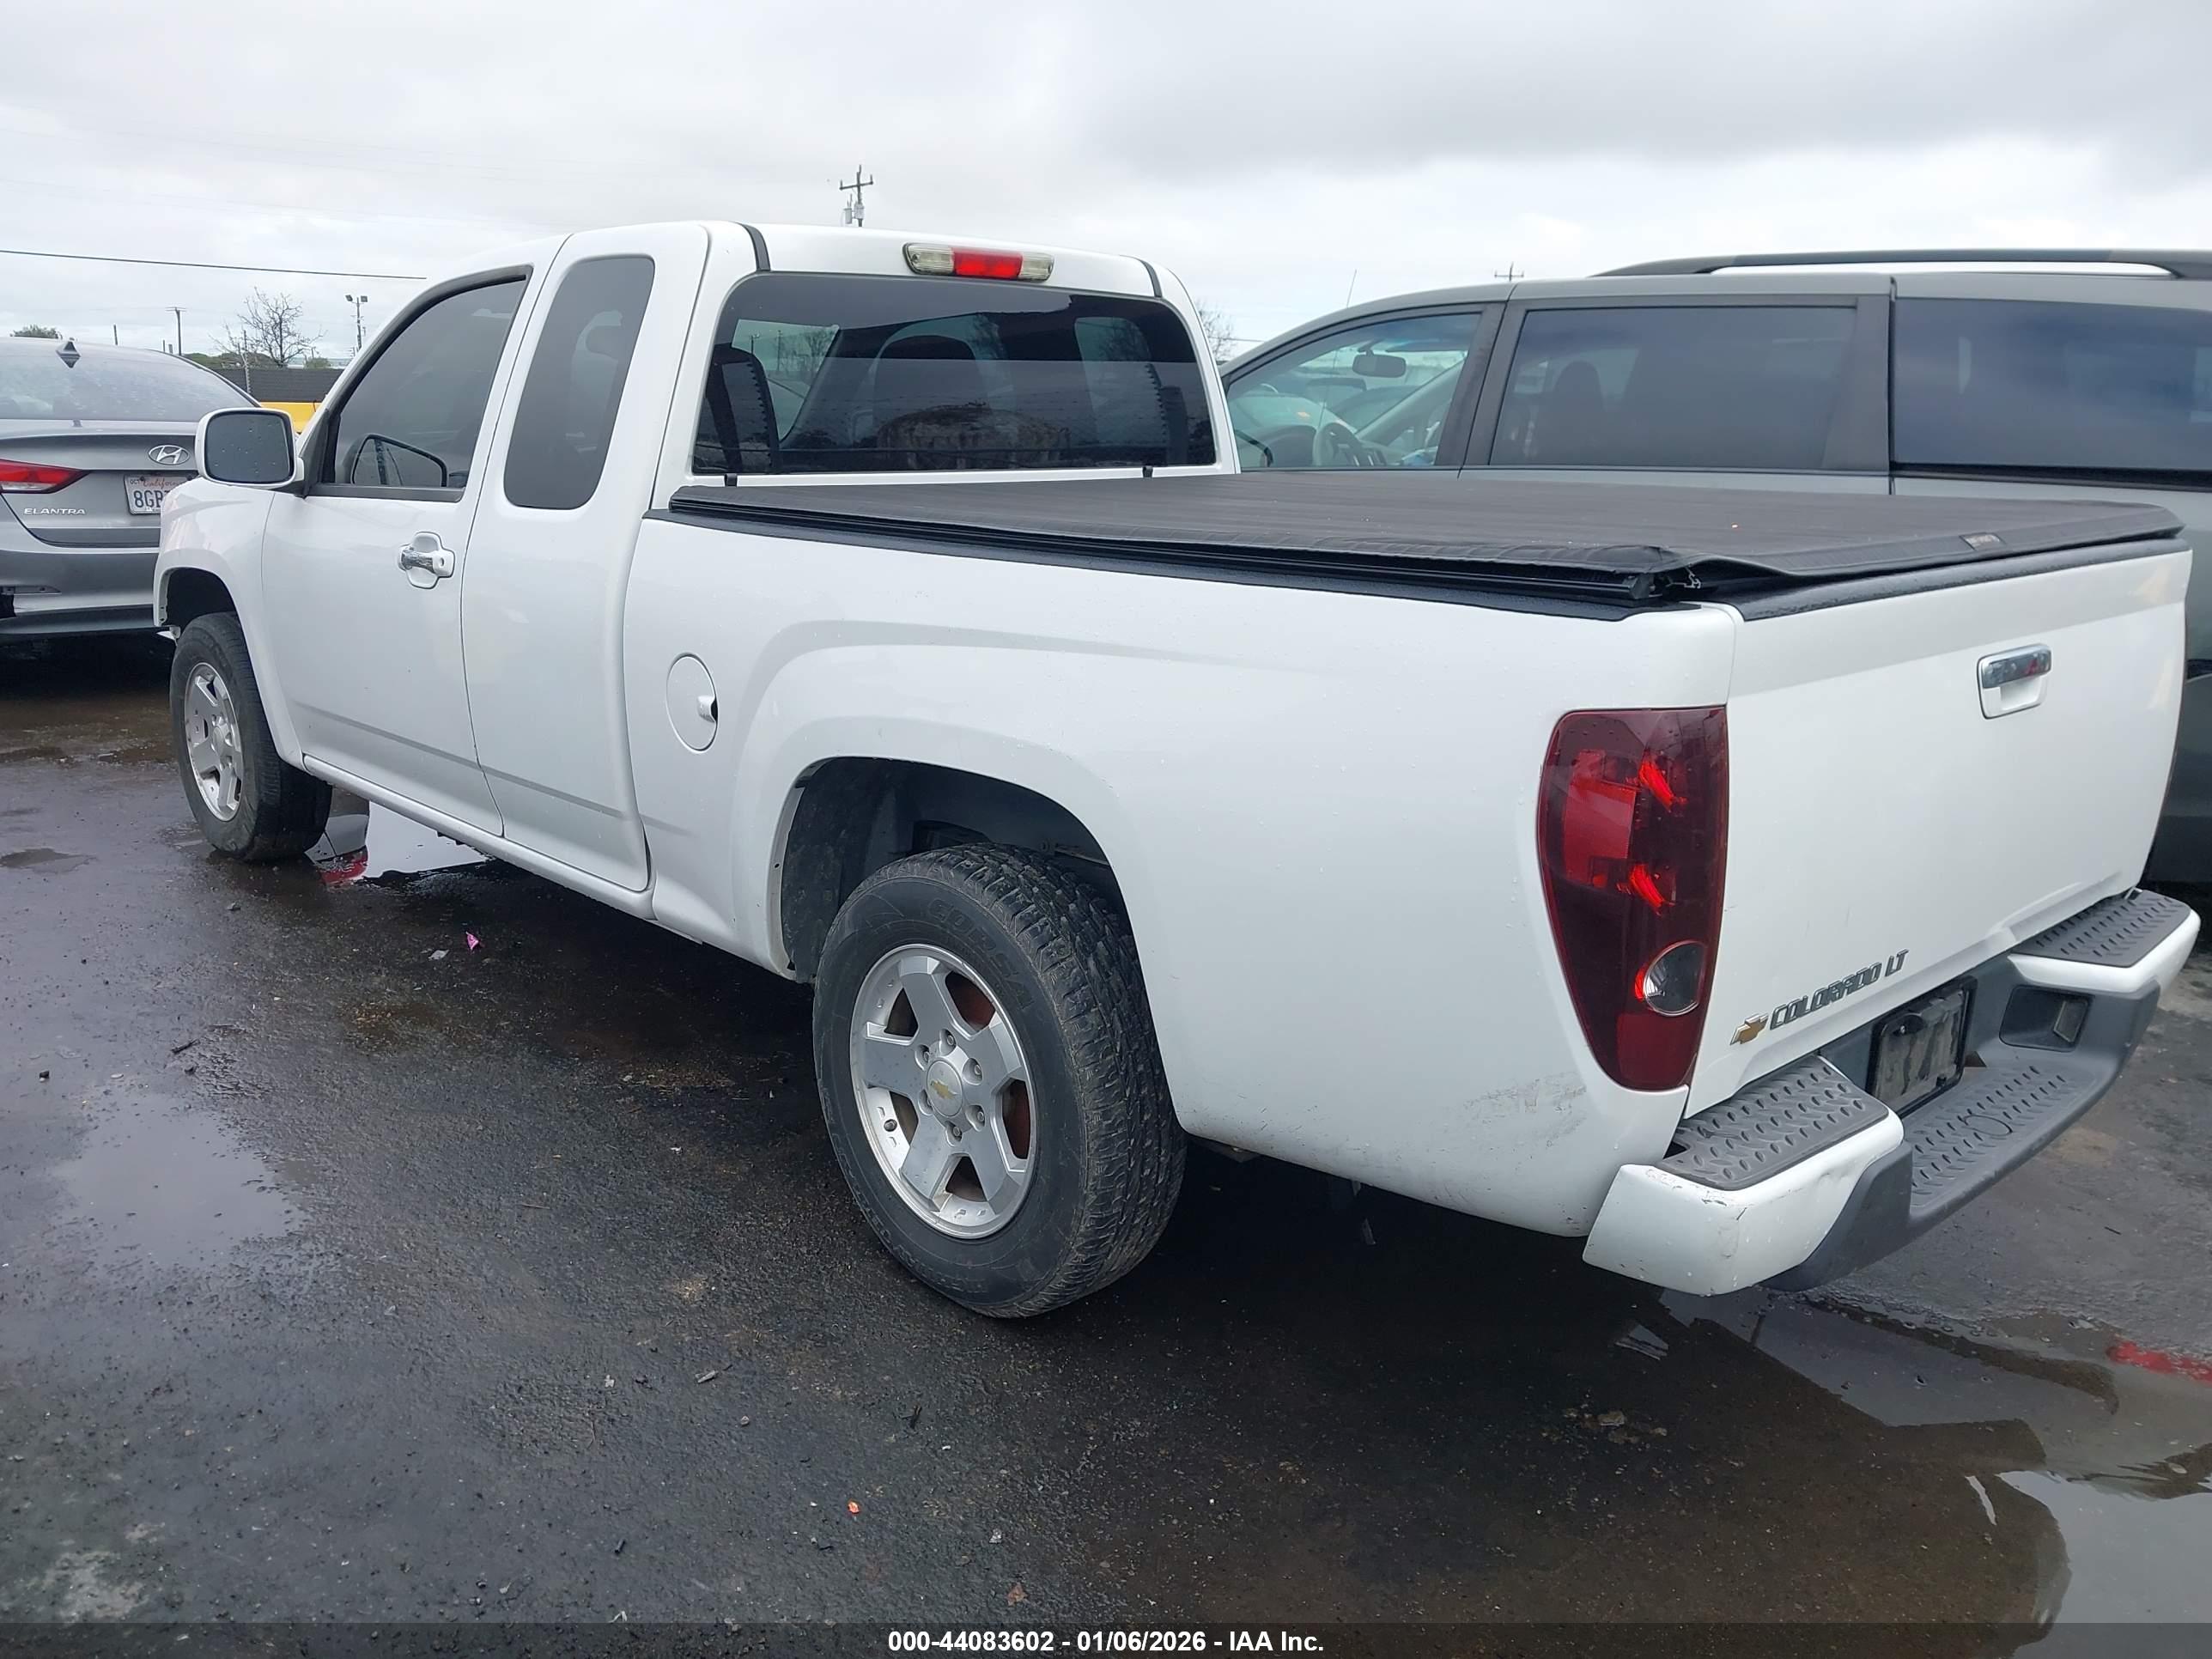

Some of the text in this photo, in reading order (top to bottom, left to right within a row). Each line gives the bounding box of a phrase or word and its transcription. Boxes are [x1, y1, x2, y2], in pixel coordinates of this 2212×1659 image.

[133, 490, 170, 508] 8GB
[23, 507, 86, 516] ELANTRA
[1769, 948, 1909, 1030] COLORADO LT
